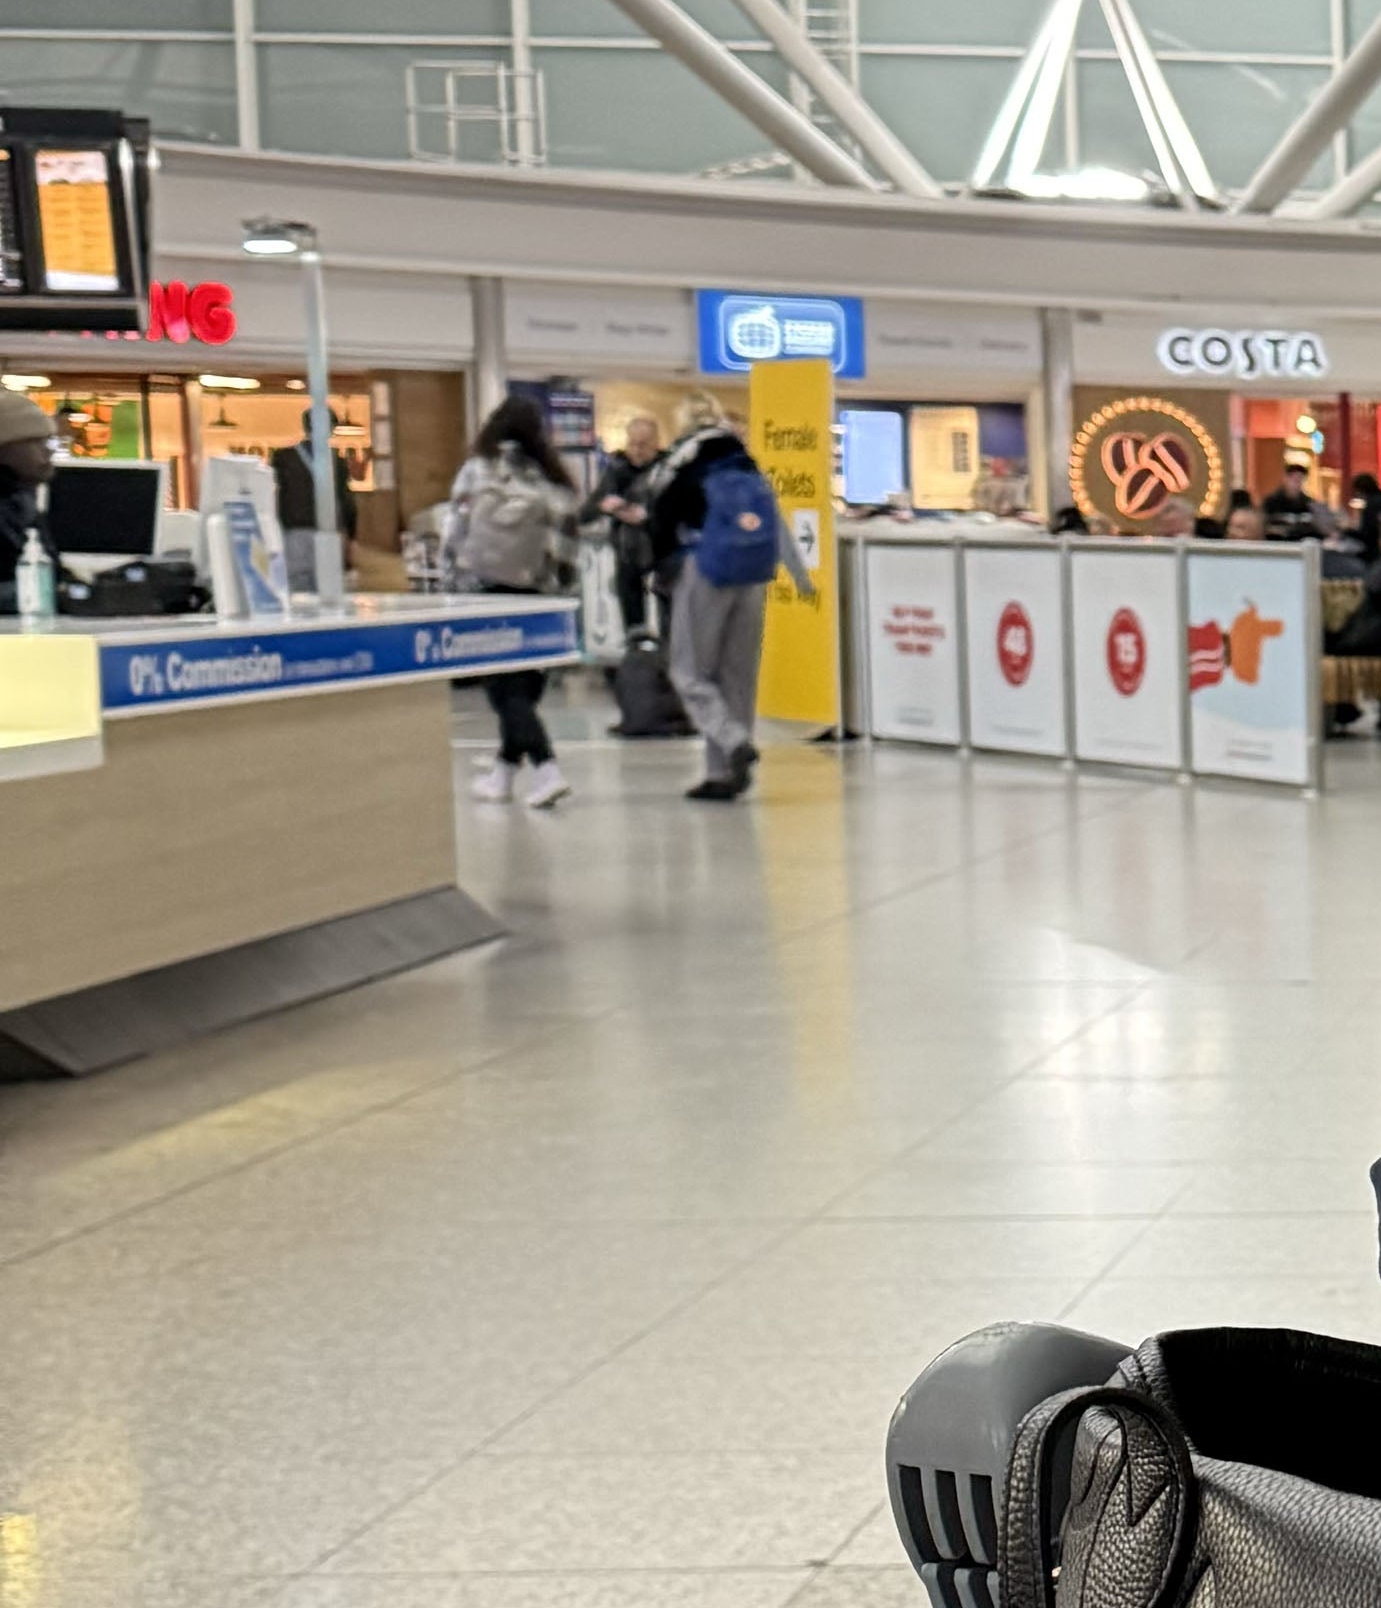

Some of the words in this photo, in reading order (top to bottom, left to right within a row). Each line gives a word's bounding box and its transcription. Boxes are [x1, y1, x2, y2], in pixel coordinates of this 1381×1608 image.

[1166, 334, 1325, 375] COSTA
[130, 652, 164, 696] 0%
[167, 643, 283, 692] Commission
